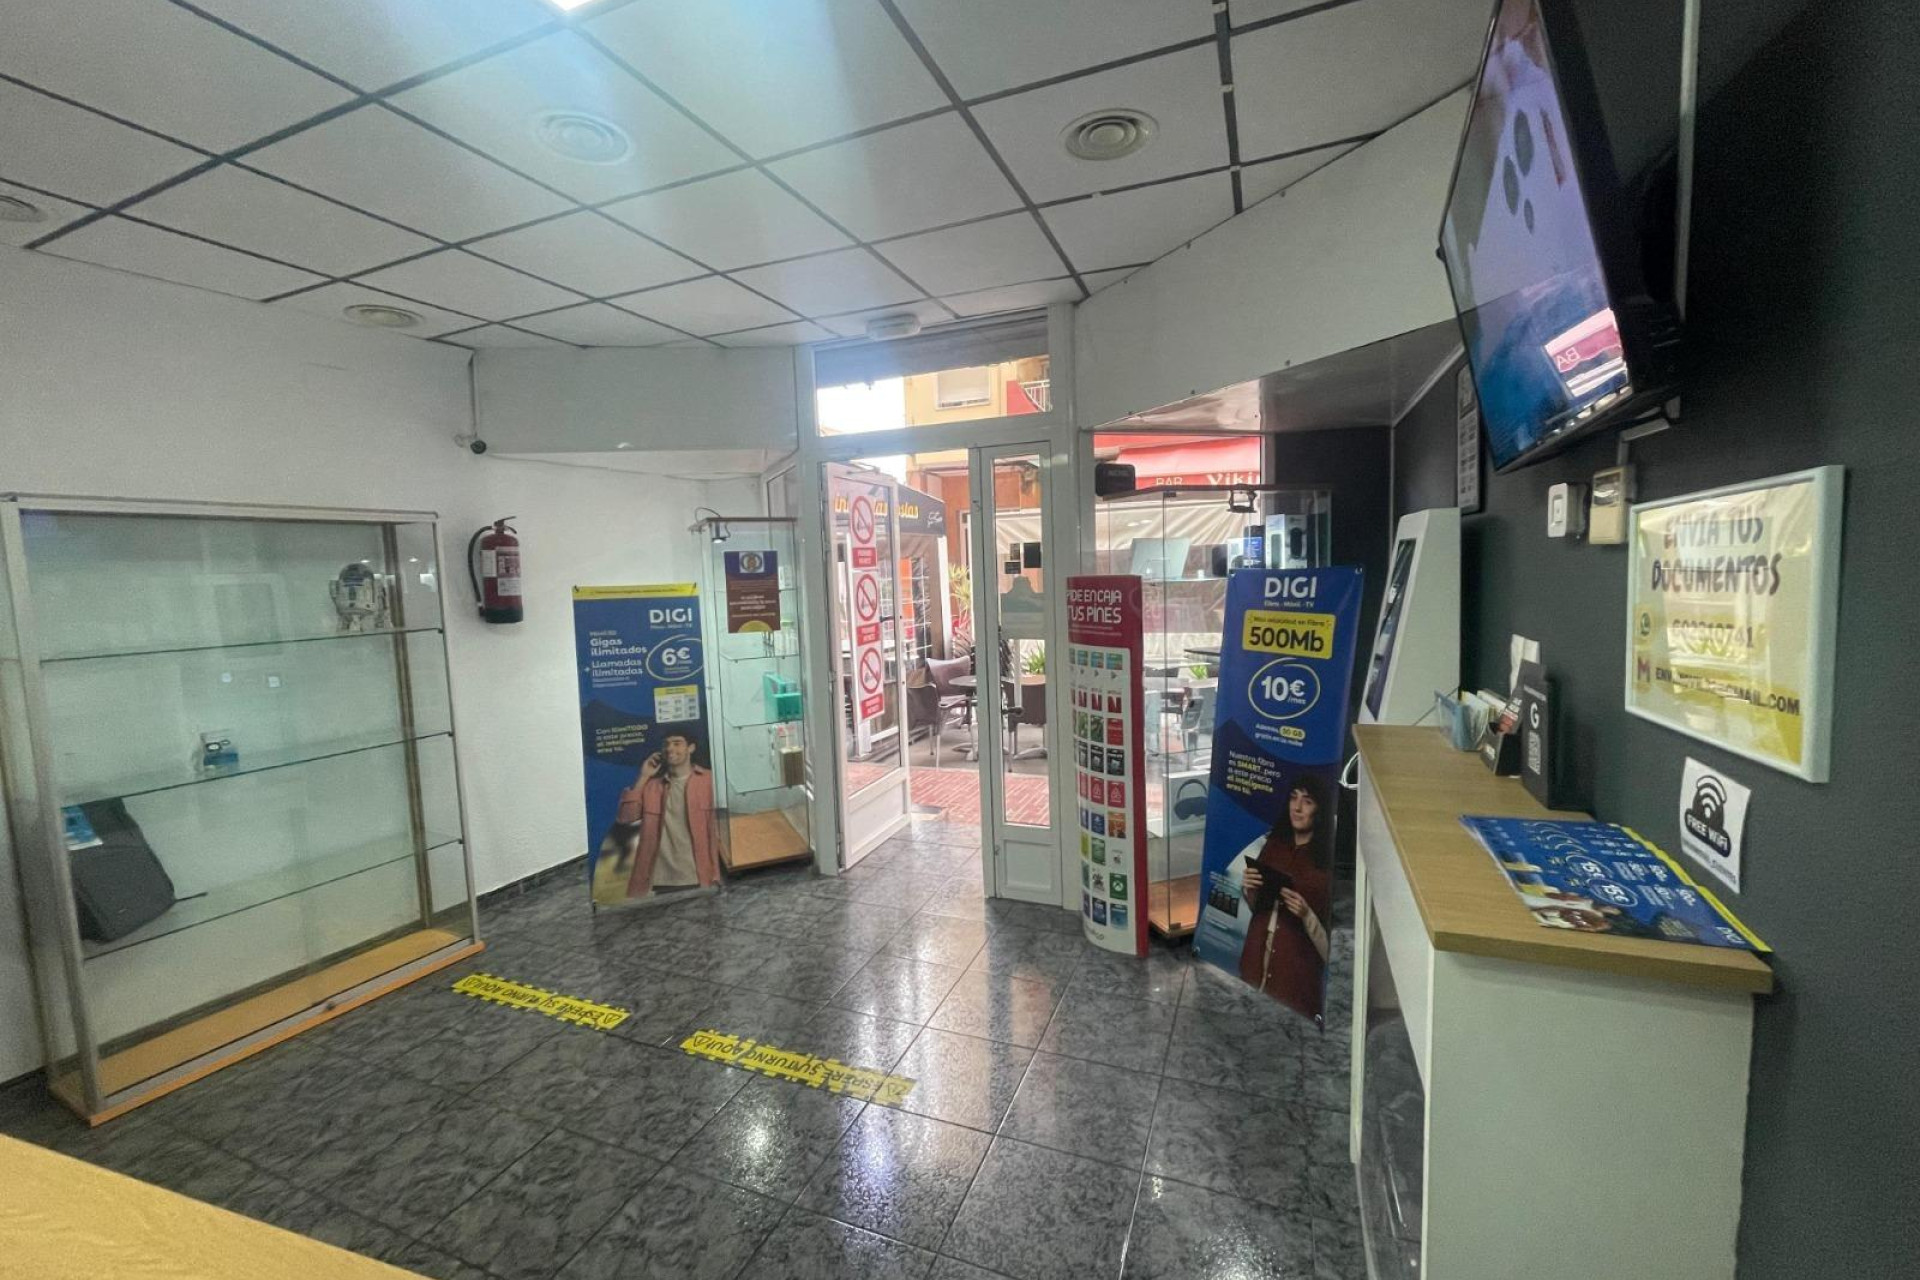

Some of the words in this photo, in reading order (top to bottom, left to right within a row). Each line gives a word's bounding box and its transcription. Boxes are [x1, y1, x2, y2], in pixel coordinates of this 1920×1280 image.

[1663, 511, 1720, 549] ENVIA
[1729, 508, 1764, 545] TUS
[1652, 553, 1782, 596] DOCUMENTOS
[1264, 576, 1317, 598] DIGI
[1098, 590, 1122, 604] CAJA
[649, 608, 692, 623] DIGI
[590, 638, 622, 648] Gigas
[1249, 626, 1325, 652] 500Mb
[592, 645, 647, 655] ilimitados
[661, 647, 691, 666] 6€
[592, 659, 641, 668] Llamadas
[592, 667, 643, 676] ilimitadas
[1261, 676, 1306, 701] 10€
[1687, 814, 1707, 837] FREE
[559, 1003, 603, 1021] ESPERE
[821, 1066, 879, 1090] ESPERE
